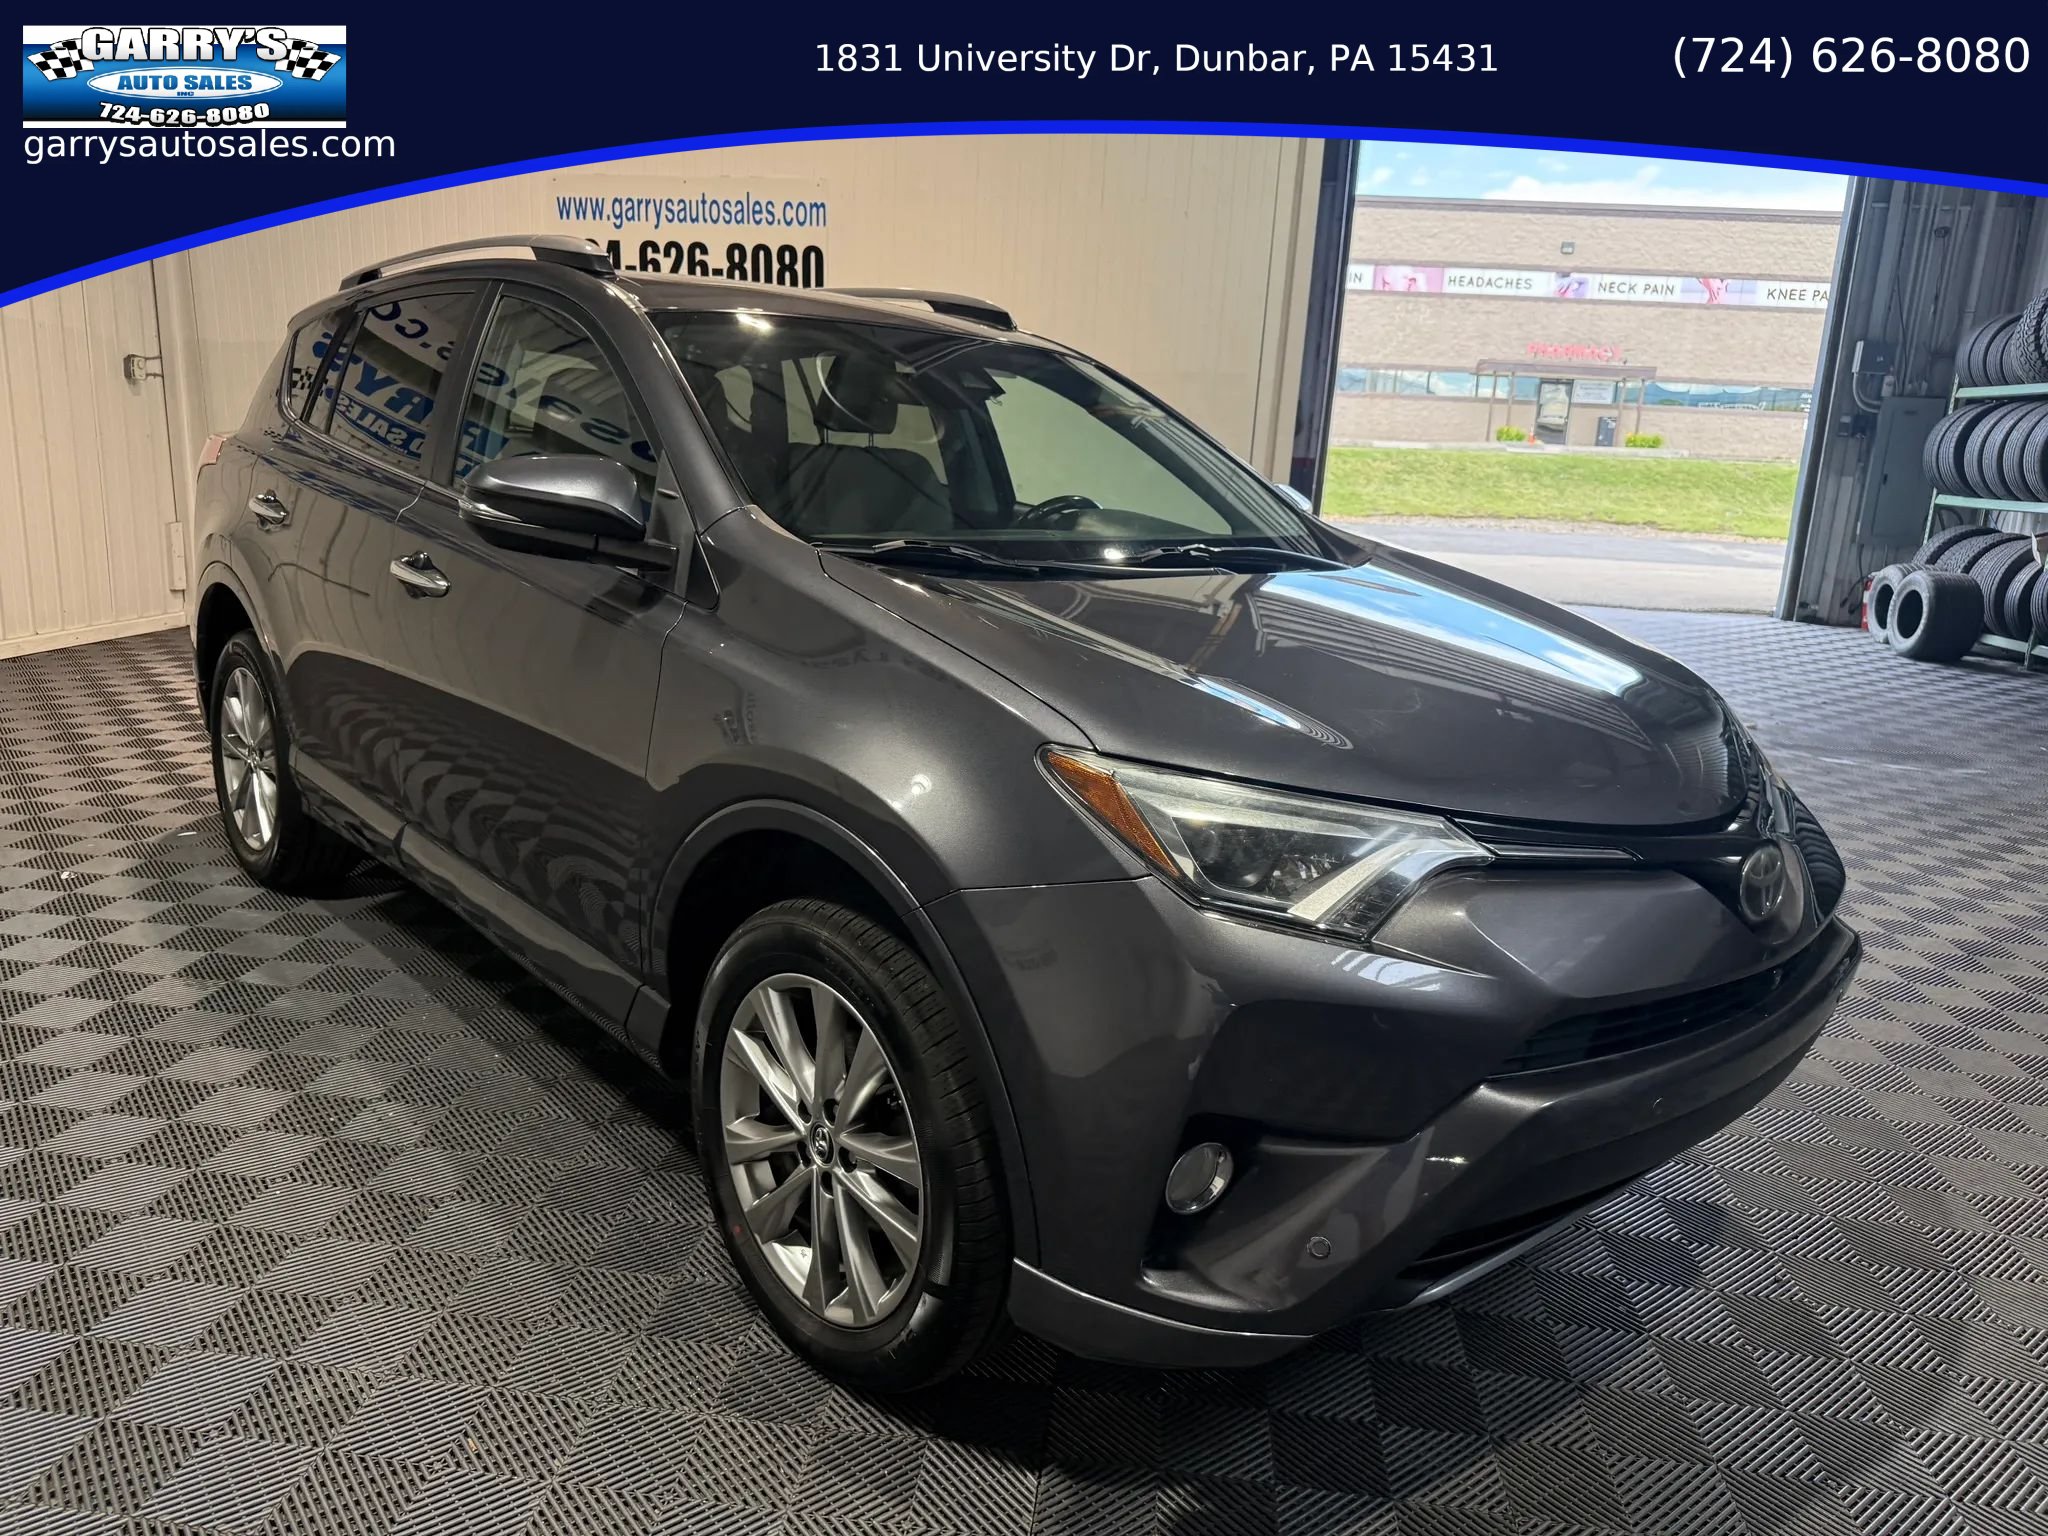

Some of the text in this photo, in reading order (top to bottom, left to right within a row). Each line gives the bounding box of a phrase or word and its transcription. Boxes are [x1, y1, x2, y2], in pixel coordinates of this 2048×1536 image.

[556, 191, 827, 229] www.garrysautosales.com
[1447, 275, 1534, 290] HEADACHES
[1598, 281, 1675, 296] NECK PAIN
[1767, 288, 1807, 301] KNEE
